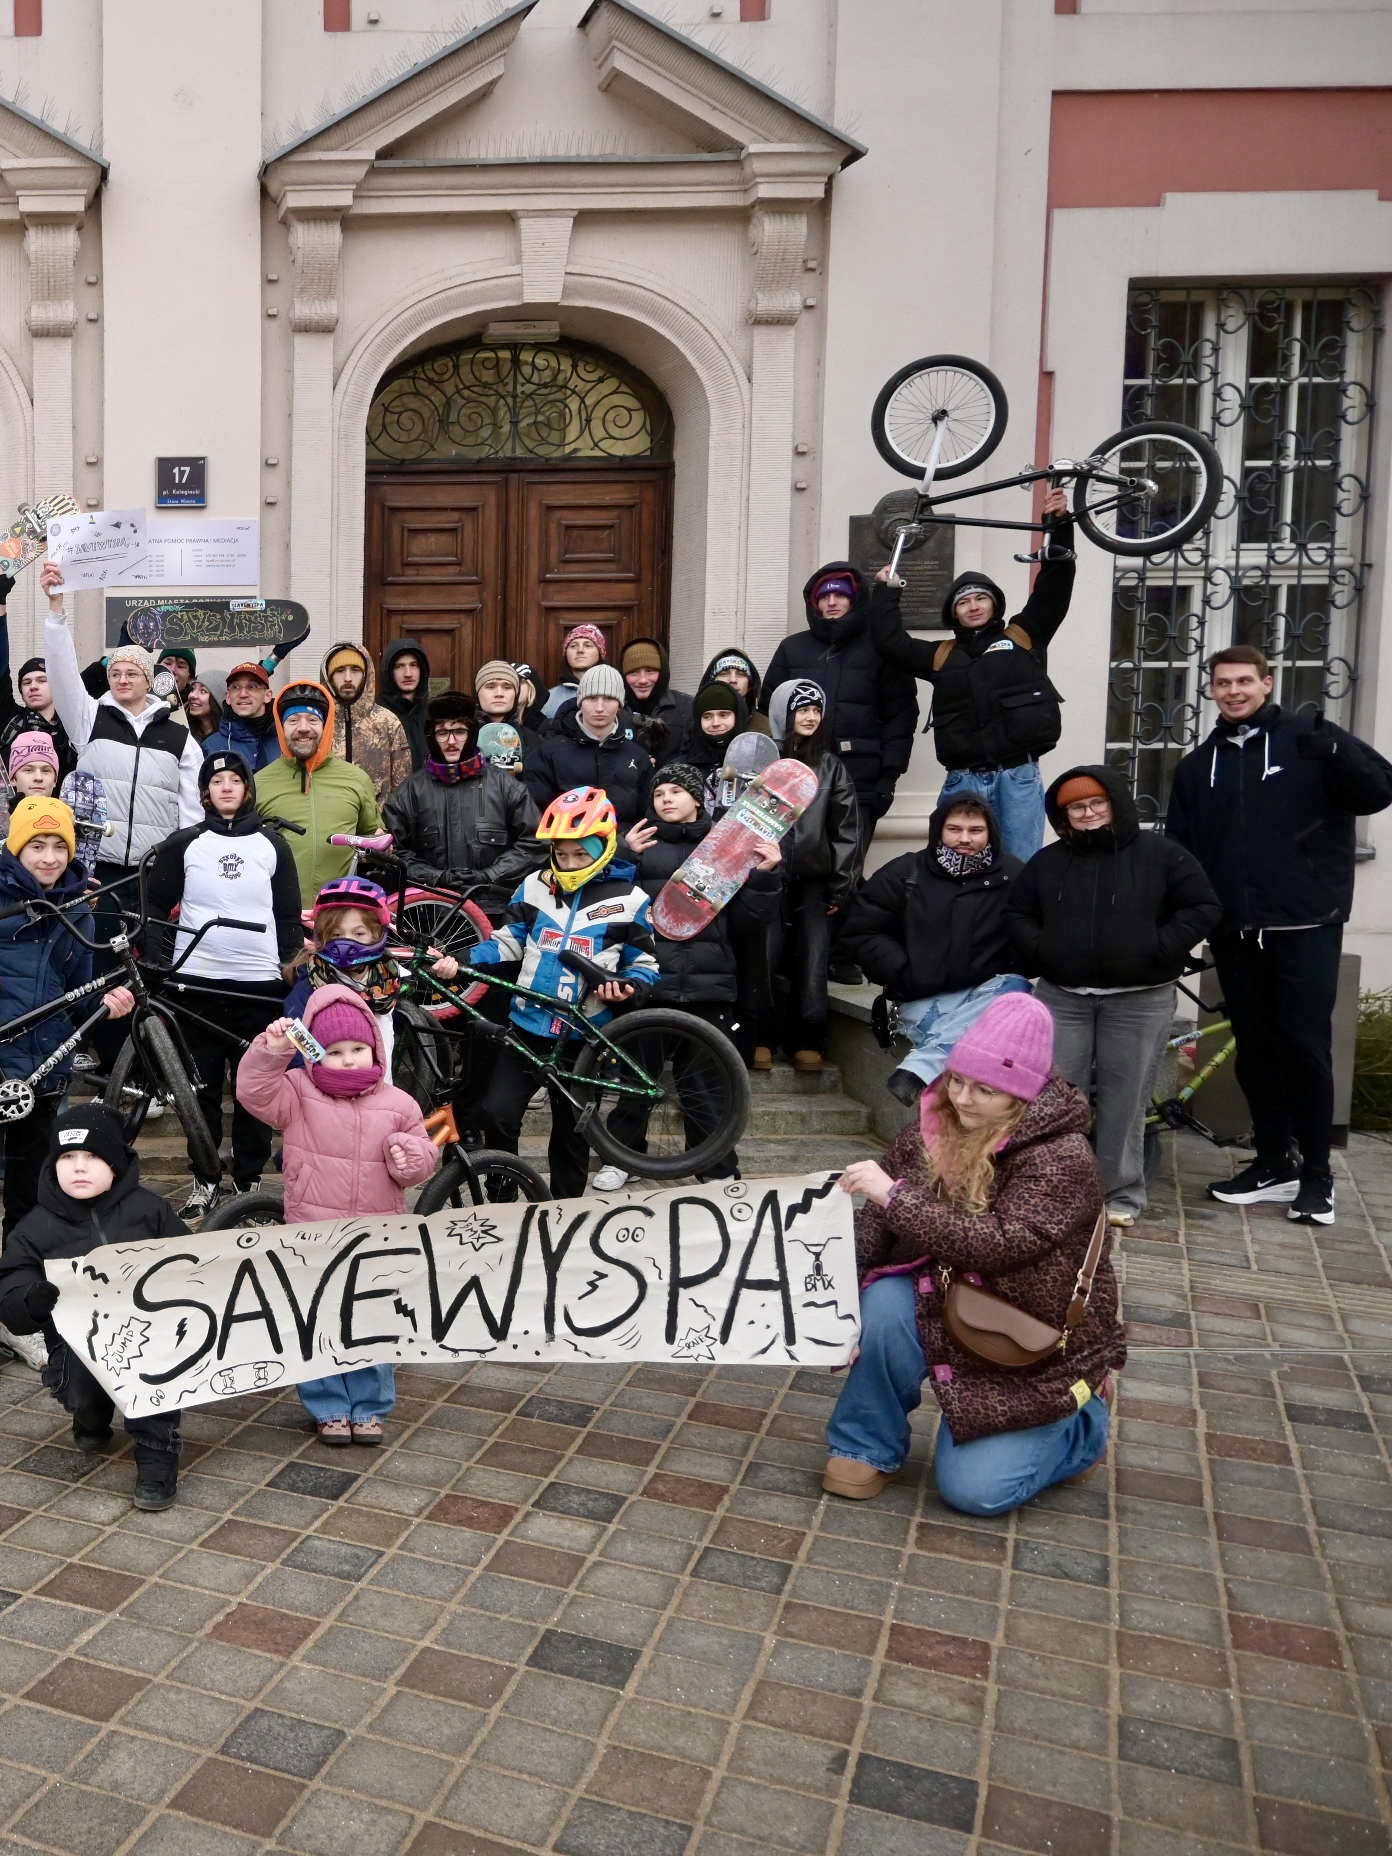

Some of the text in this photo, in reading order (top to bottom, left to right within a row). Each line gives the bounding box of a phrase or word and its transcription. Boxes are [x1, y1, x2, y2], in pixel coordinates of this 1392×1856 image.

[172, 466, 190, 484] 17
[804, 1275, 836, 1292] BMX
[111, 1330, 133, 1363] JUMP
